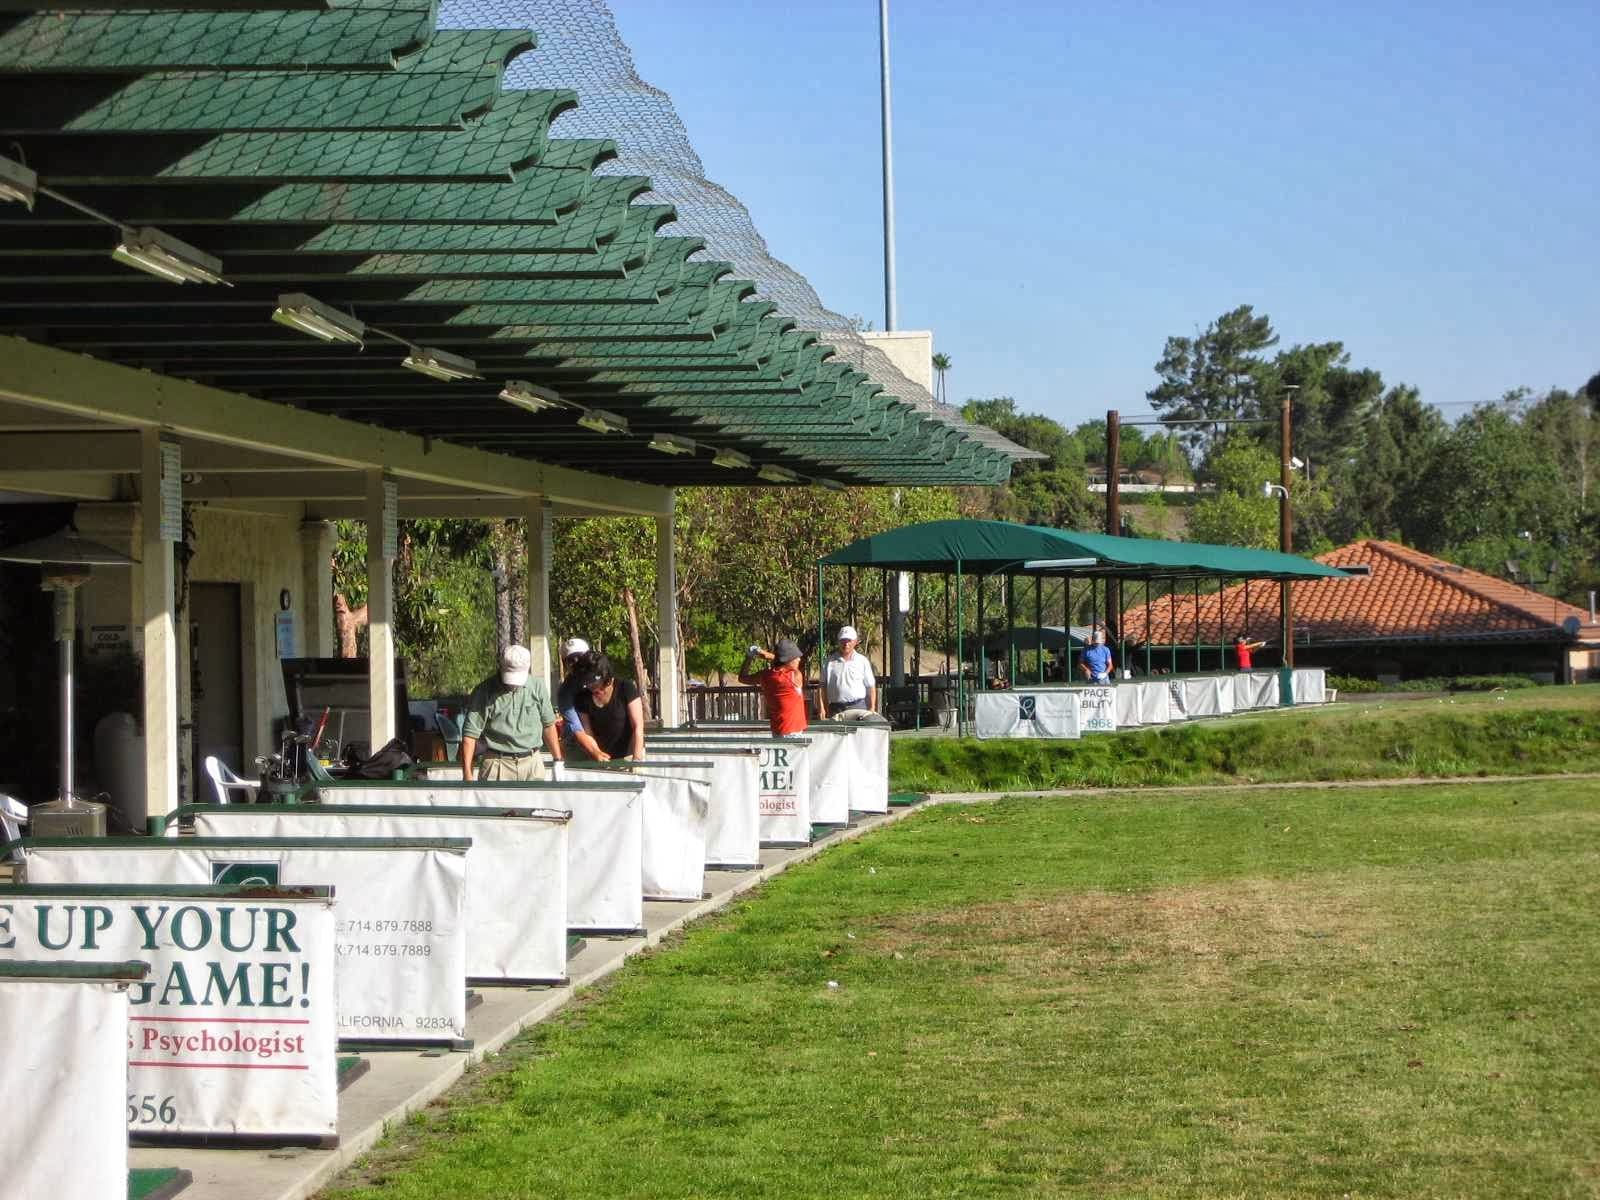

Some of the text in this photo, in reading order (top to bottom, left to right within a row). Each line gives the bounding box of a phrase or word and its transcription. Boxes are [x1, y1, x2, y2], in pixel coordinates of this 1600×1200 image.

[1084, 689, 1110, 698] PACE
[1080, 700, 1113, 709] BILITY
[34, 905, 114, 950] UP
[131, 905, 302, 952] YOUR
[415, 1016, 455, 1029] 92834
[142, 1028, 305, 1058] Psychologist
